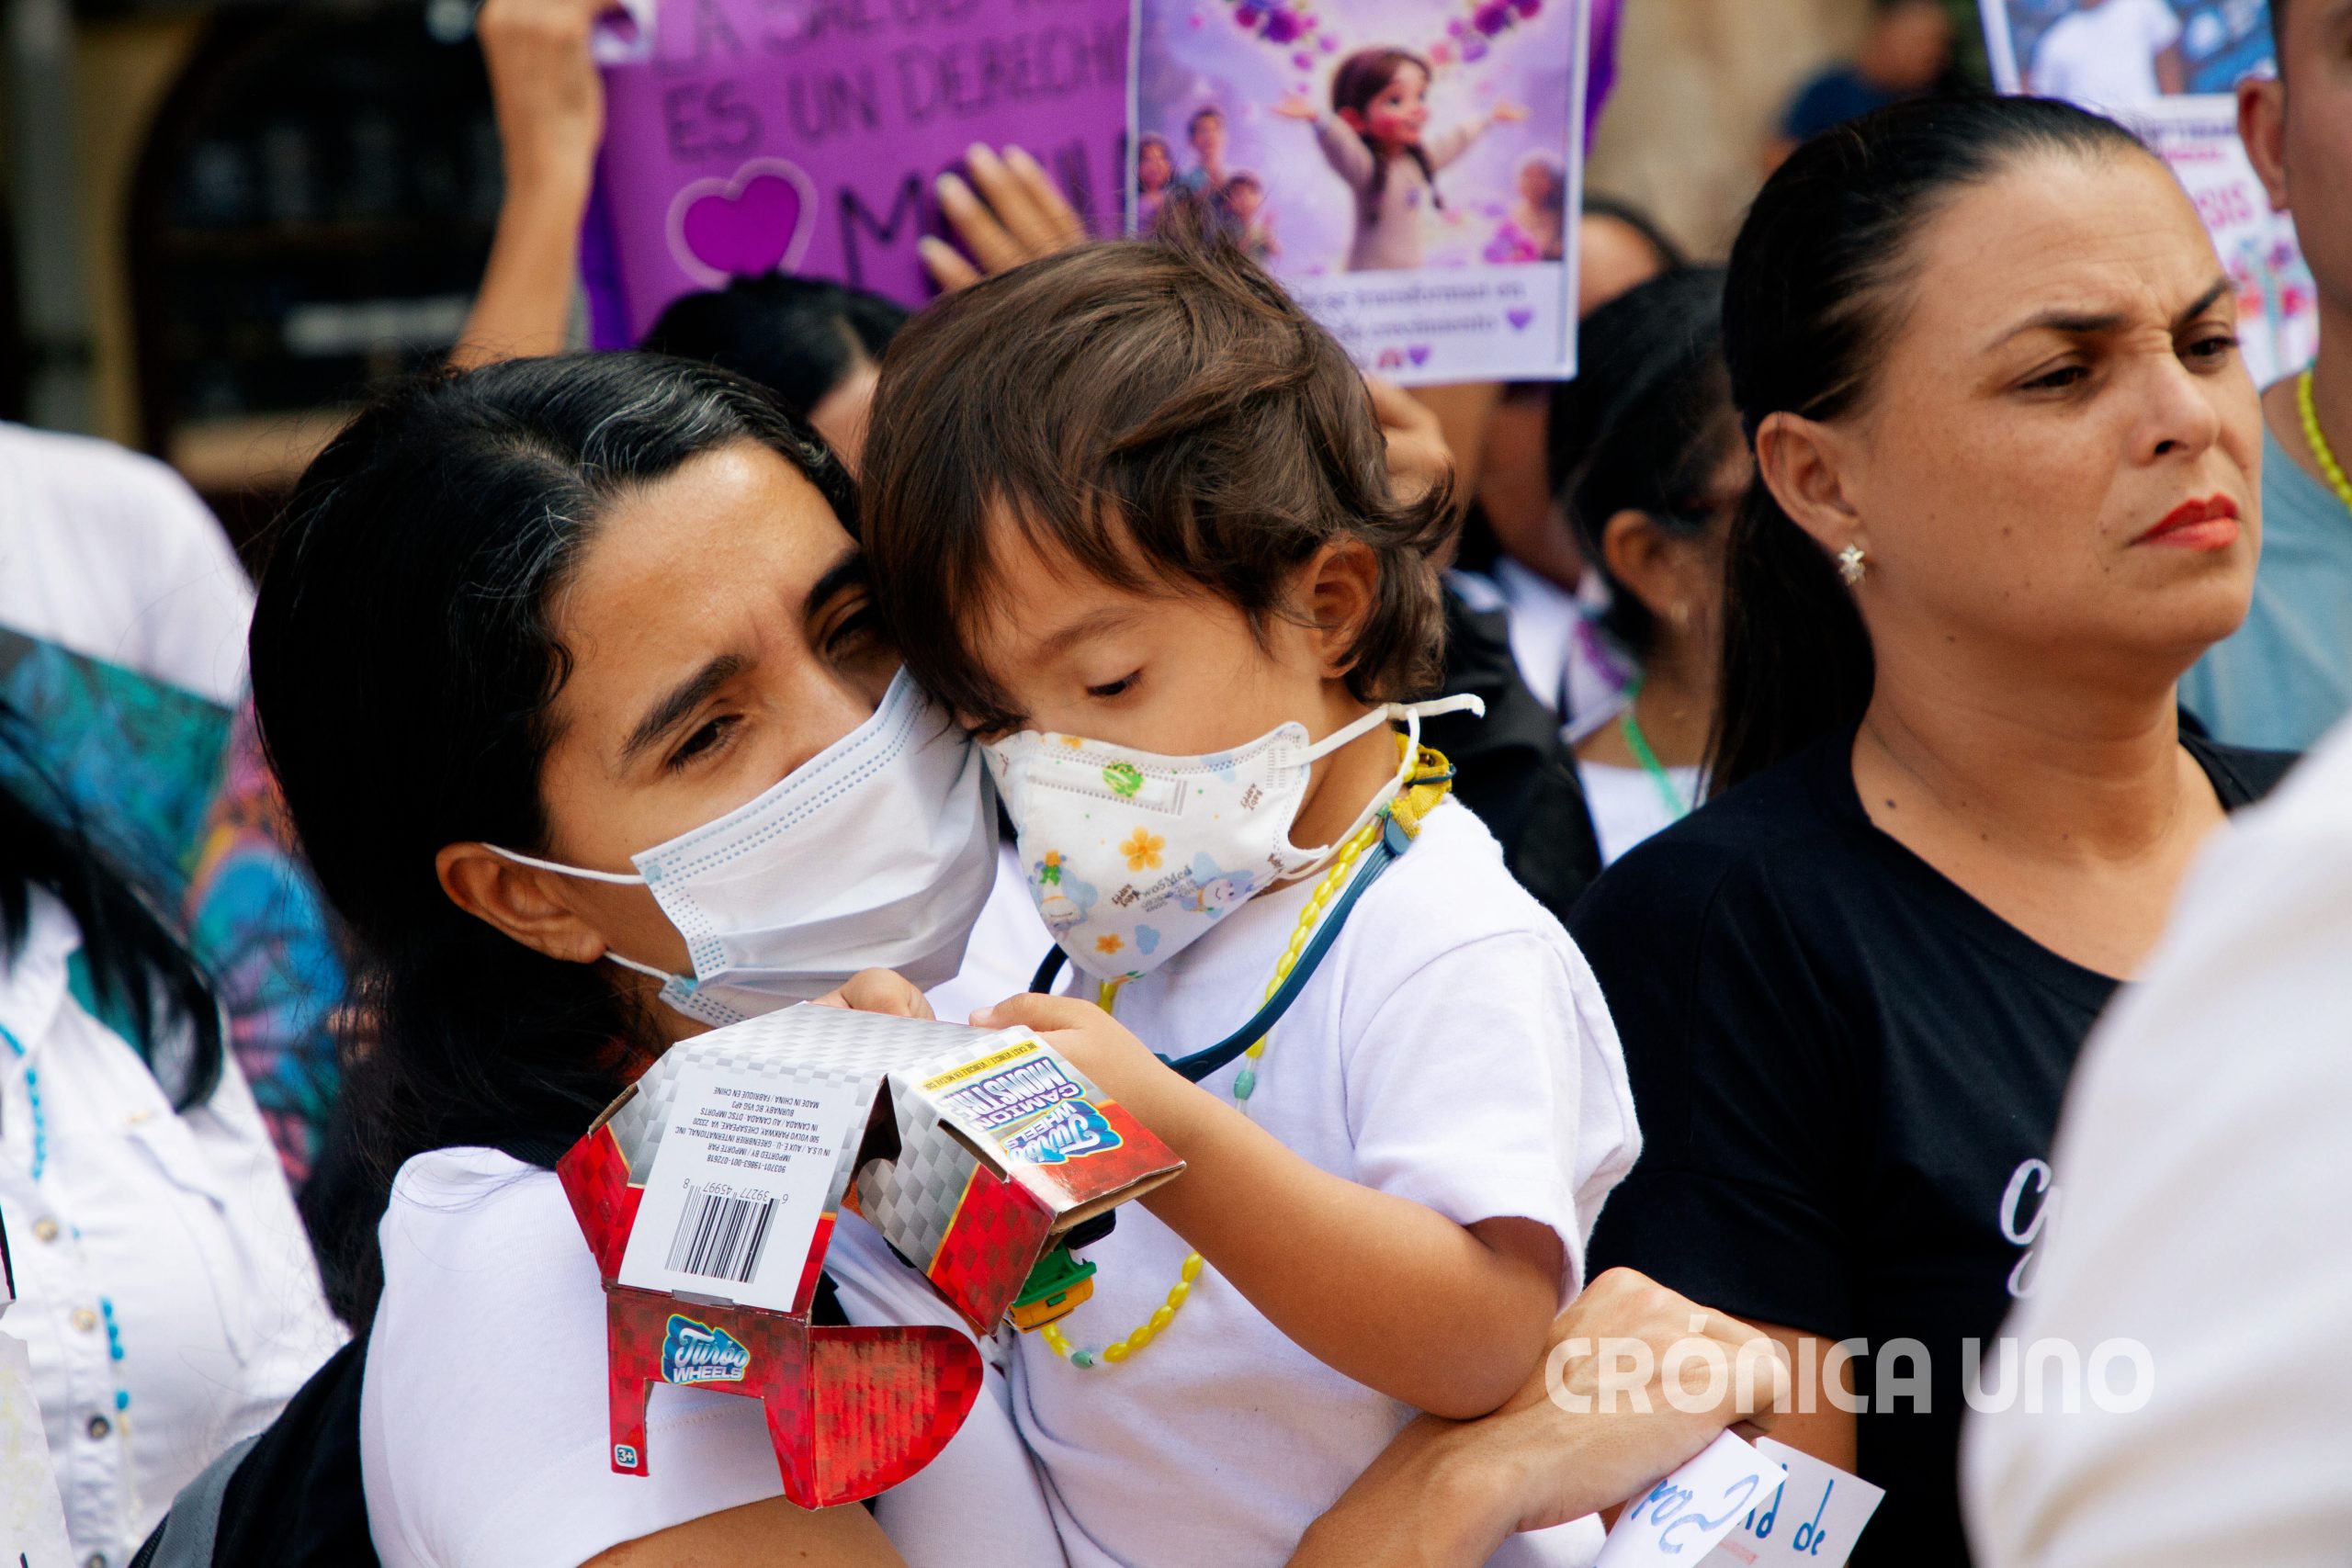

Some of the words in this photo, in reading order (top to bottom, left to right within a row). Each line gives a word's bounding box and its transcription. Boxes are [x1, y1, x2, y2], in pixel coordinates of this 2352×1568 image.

[663, 78, 765, 164] ES
[786, 66, 882, 145] UN
[713, 1087, 732, 1096] CHINE
[732, 1089, 741, 1098] EN
[937, 1058, 1066, 1121] MONSTRE
[775, 1096, 794, 1105] CHINA
[801, 1100, 820, 1109] MADE
[755, 1104, 764, 1112] BC
[966, 1083, 1078, 1131] CAMION
[700, 1108, 728, 1118] IMPORTS
[728, 1111, 744, 1121] DTSC
[693, 1118, 709, 1126] 23320
[772, 1118, 782, 1126] AU
[786, 1121, 810, 1131] CANADA
[1003, 1101, 1077, 1149] WHEELS
[811, 1123, 819, 1132] IN
[736, 1136, 772, 1147] GREENBRIER
[790, 1133, 808, 1142] VOLVO
[809, 1135, 820, 1144] 500
[1011, 1114, 1099, 1161] Turbo
[707, 1143, 720, 1151] PAR
[789, 1144, 802, 1152] AUX
[823, 1148, 831, 1156] IN
[761, 1151, 791, 1162] IMPORTED
[683, 1178, 690, 1189] 8
[703, 1182, 732, 1195] 45997
[740, 1188, 770, 1201] 39277
[782, 1193, 789, 1204] 6
[673, 1327, 748, 1368] Turbo
[673, 1365, 742, 1383] WHEELS
[617, 1448, 634, 1462] 3+
[1792, 1478, 1834, 1555] de
